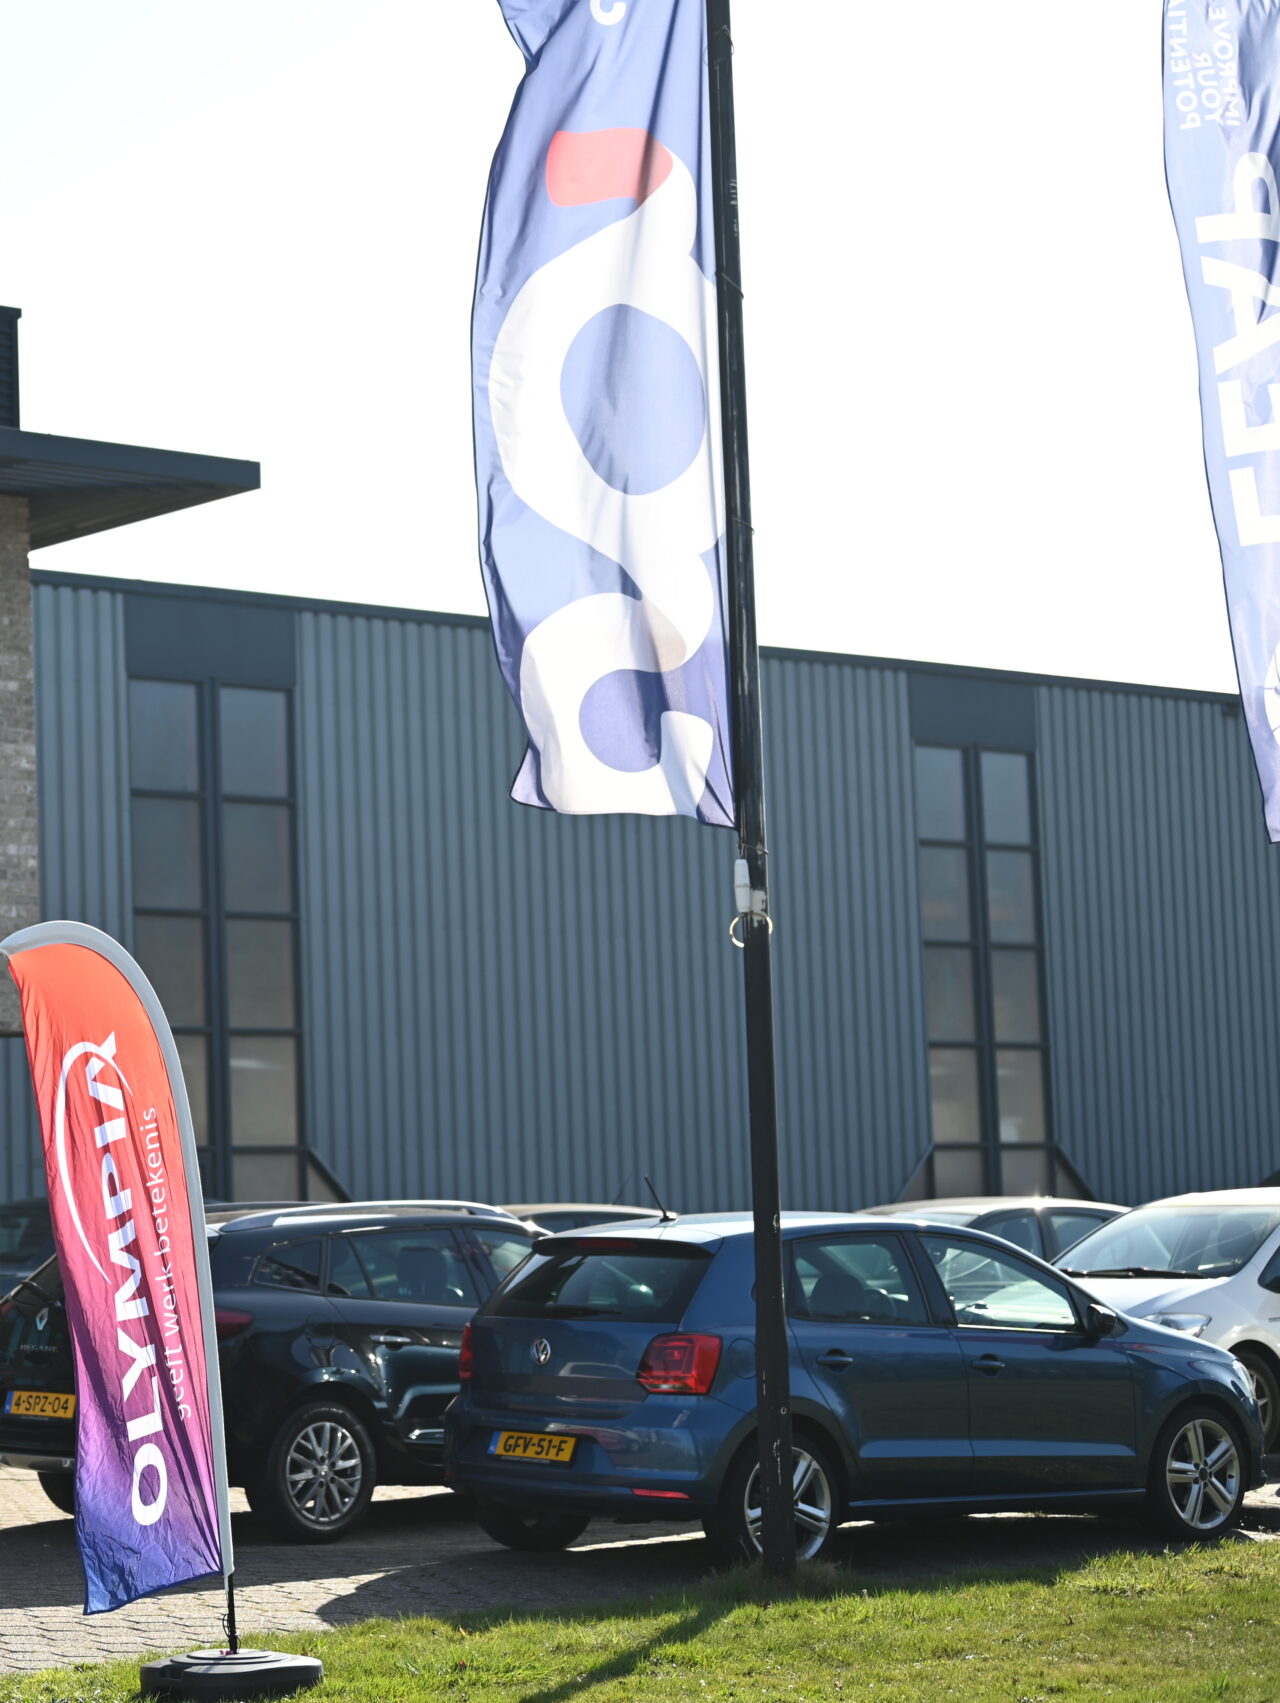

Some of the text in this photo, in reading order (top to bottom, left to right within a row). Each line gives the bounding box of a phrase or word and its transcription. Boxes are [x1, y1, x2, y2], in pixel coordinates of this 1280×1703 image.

[56, 1031, 168, 1526] OLYMPIA
[139, 1107, 191, 1421] geeft werk betekenis
[14, 1394, 69, 1414] 4-SPZ-04
[503, 1435, 569, 1458] GFV-51-F
